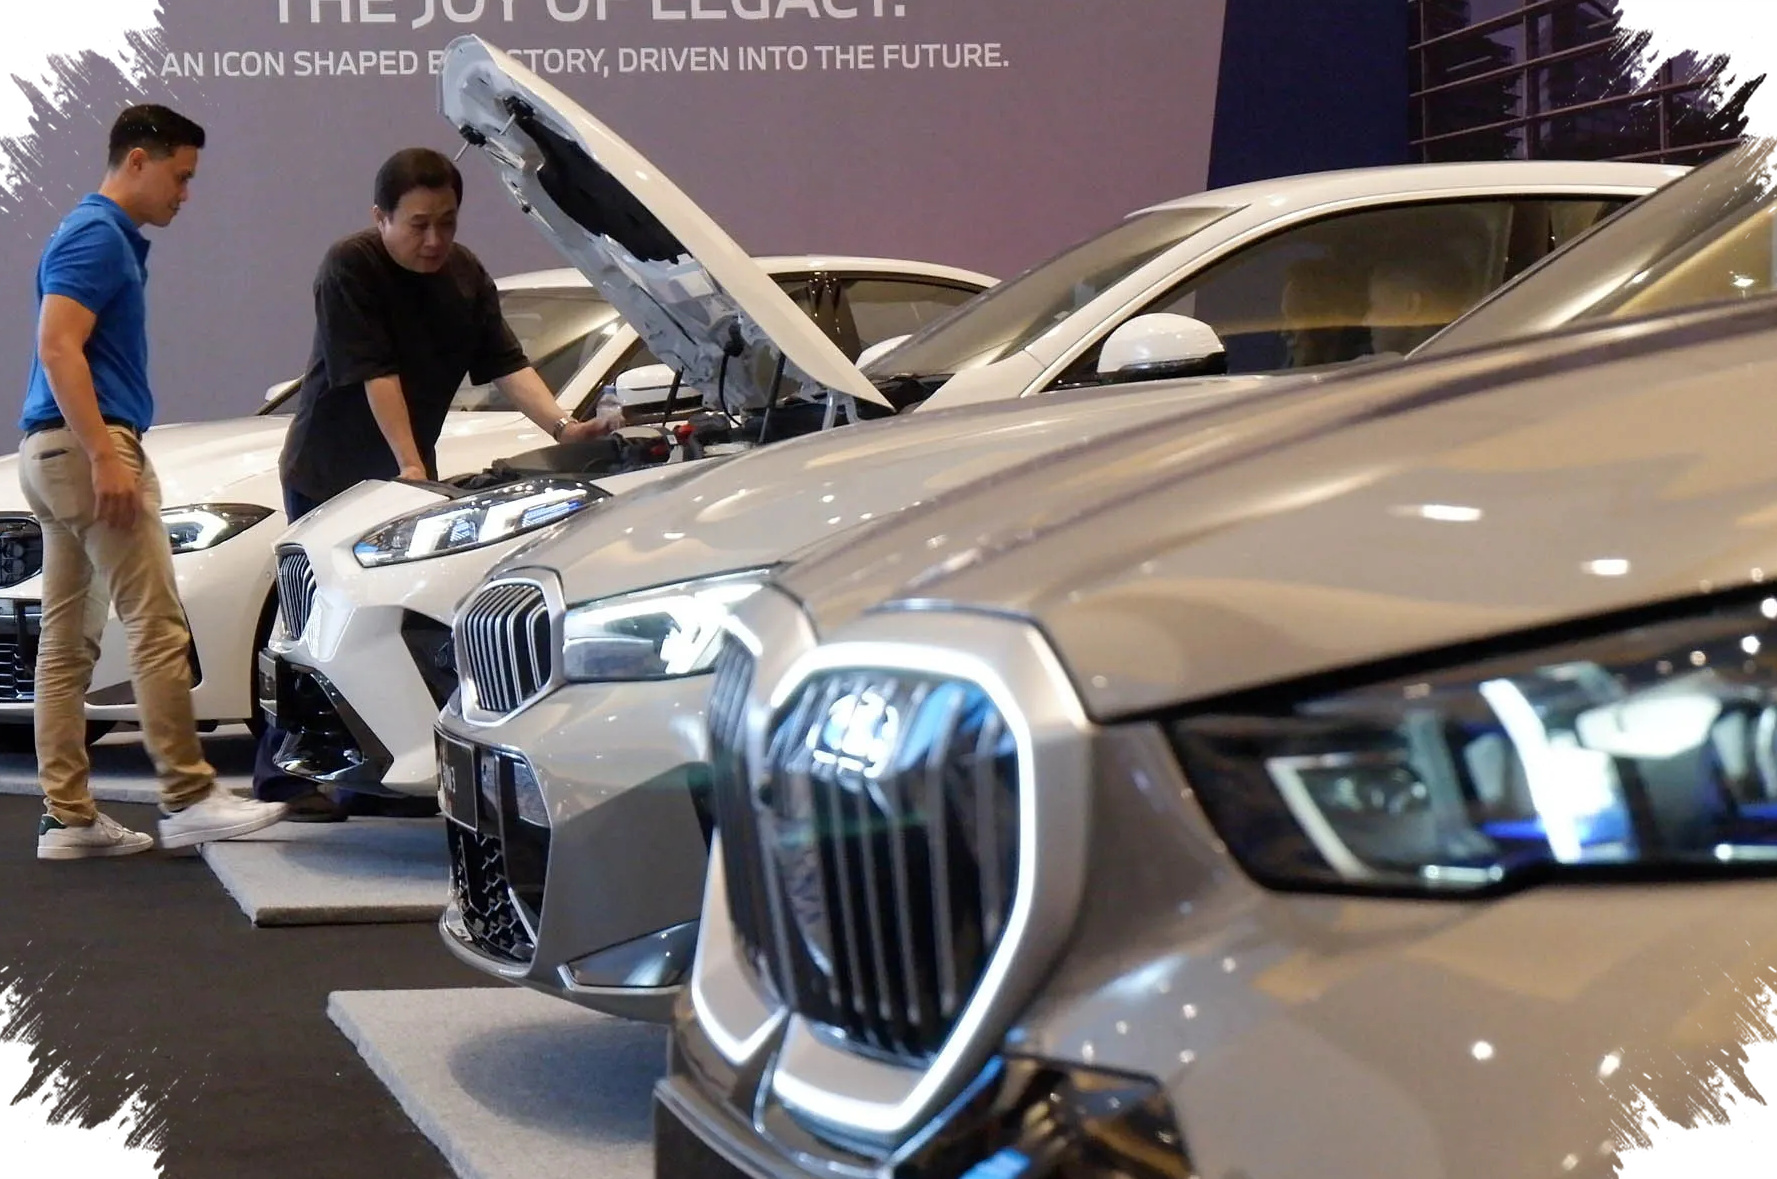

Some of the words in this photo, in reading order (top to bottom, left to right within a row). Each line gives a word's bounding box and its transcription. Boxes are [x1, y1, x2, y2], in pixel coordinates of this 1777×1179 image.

[161, 52, 204, 76] AN
[214, 51, 285, 77] ICON
[293, 50, 418, 77] SHAPED
[506, 48, 608, 78] TORY,
[618, 47, 729, 72] DRIVEN
[738, 46, 808, 71] INTO
[814, 45, 875, 70] THE
[883, 43, 1009, 69] FUTURE.
